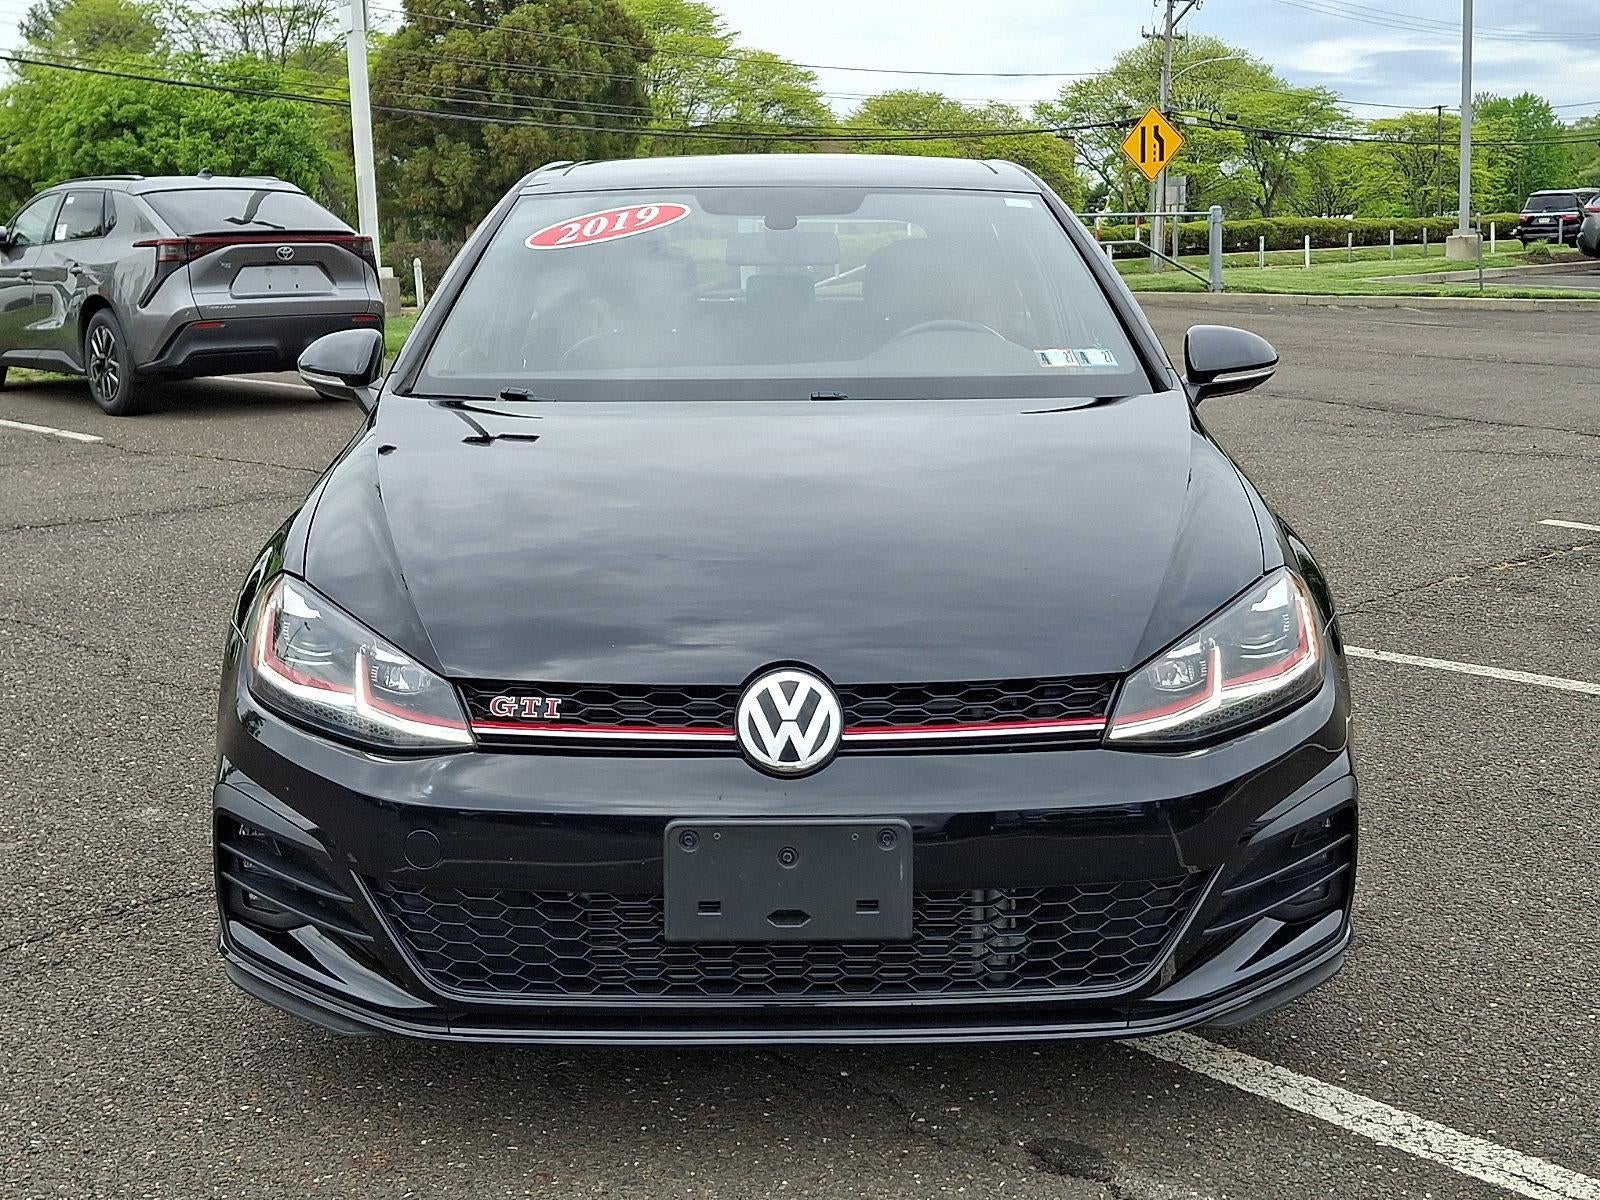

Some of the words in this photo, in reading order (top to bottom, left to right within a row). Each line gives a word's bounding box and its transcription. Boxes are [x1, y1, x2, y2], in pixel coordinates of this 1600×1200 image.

[555, 206, 661, 246] 2019
[490, 696, 561, 718] GTI
[738, 671, 841, 769] VW
